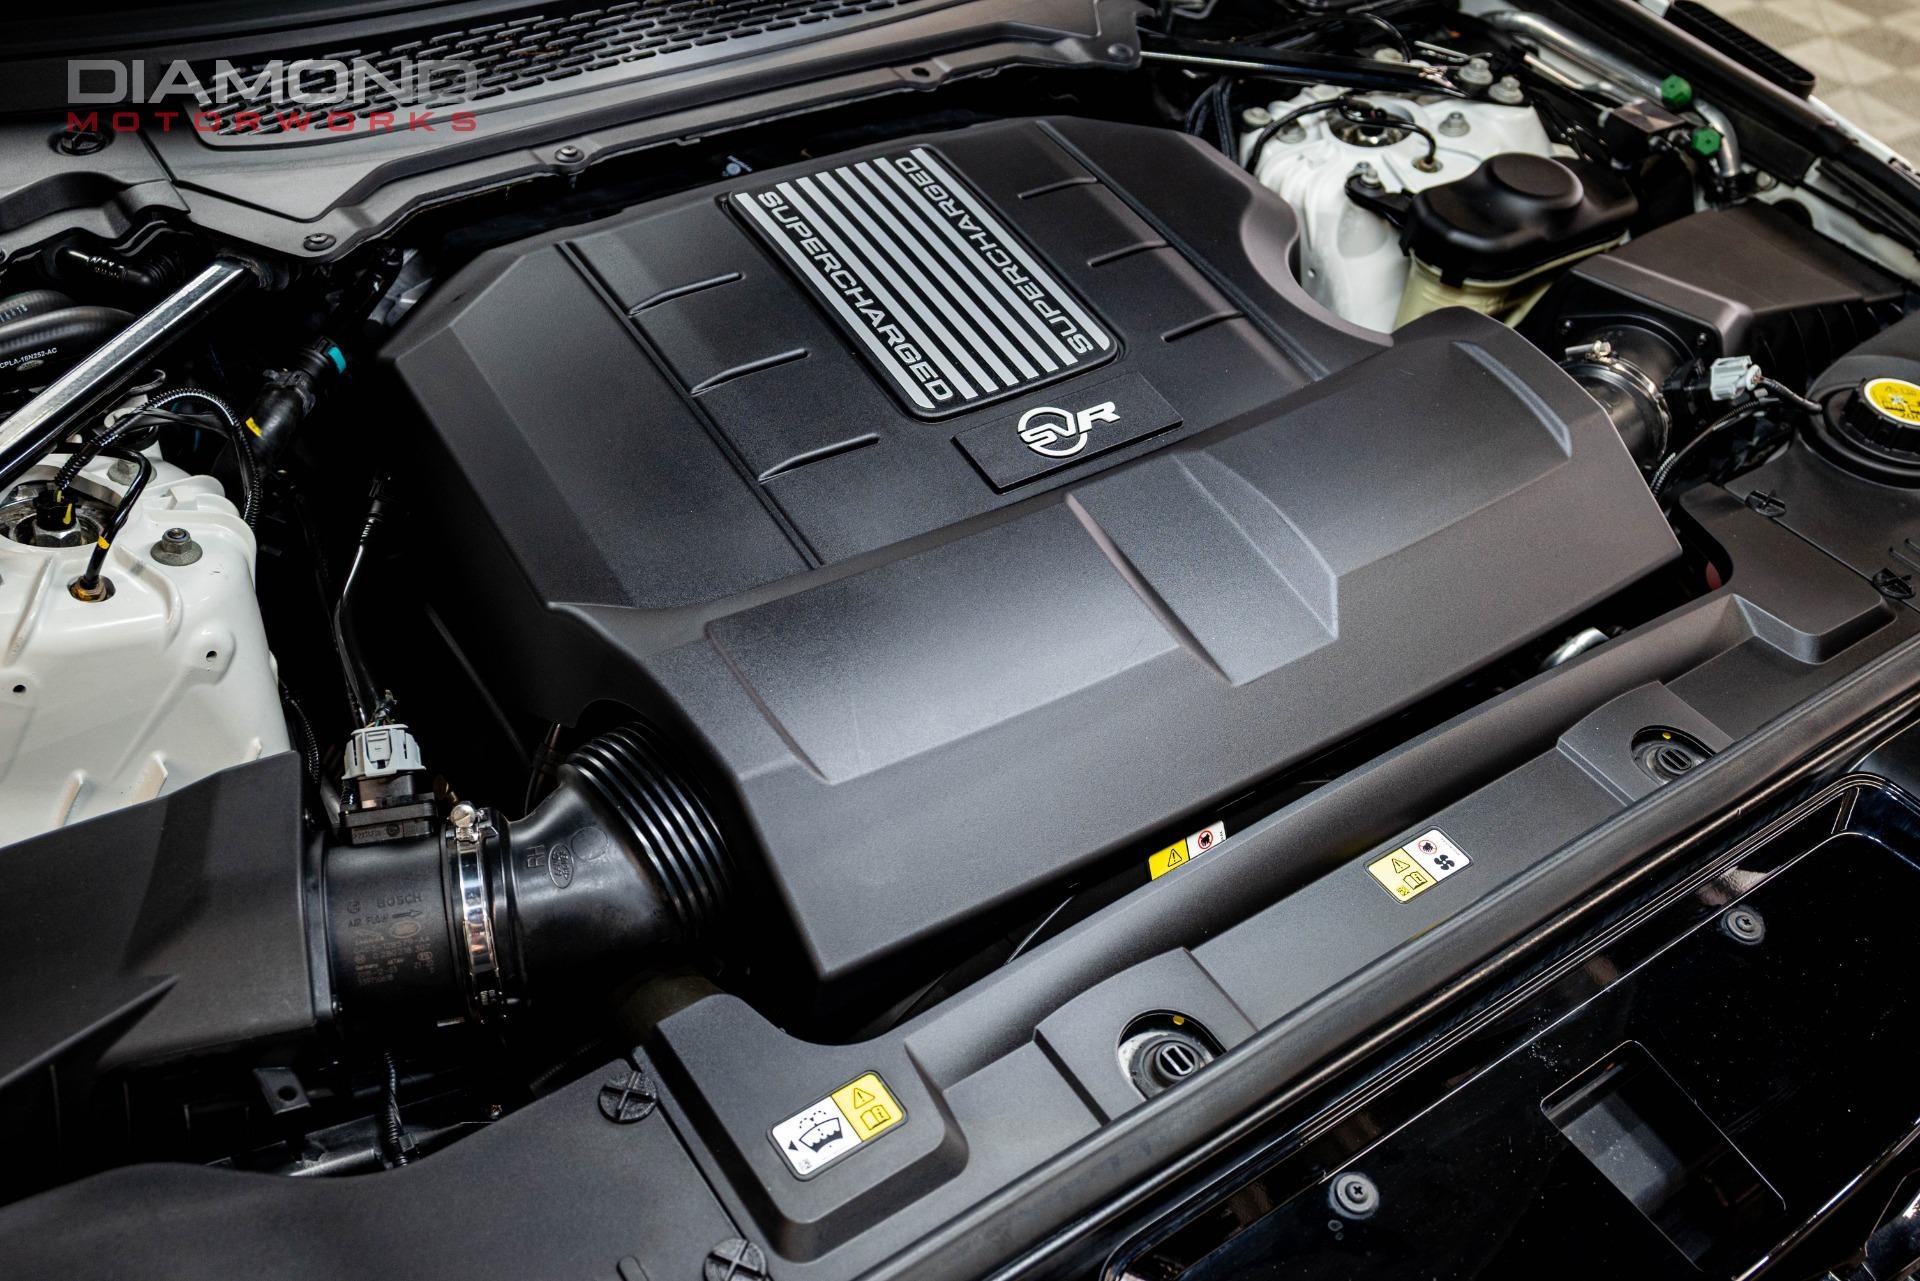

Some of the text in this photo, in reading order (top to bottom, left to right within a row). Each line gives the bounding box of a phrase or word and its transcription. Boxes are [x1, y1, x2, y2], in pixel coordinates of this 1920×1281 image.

[757, 190, 954, 402] SUPERCHARGED
[894, 156, 1093, 355] SUPERCHARGED
[1017, 401, 1121, 458] SVR
